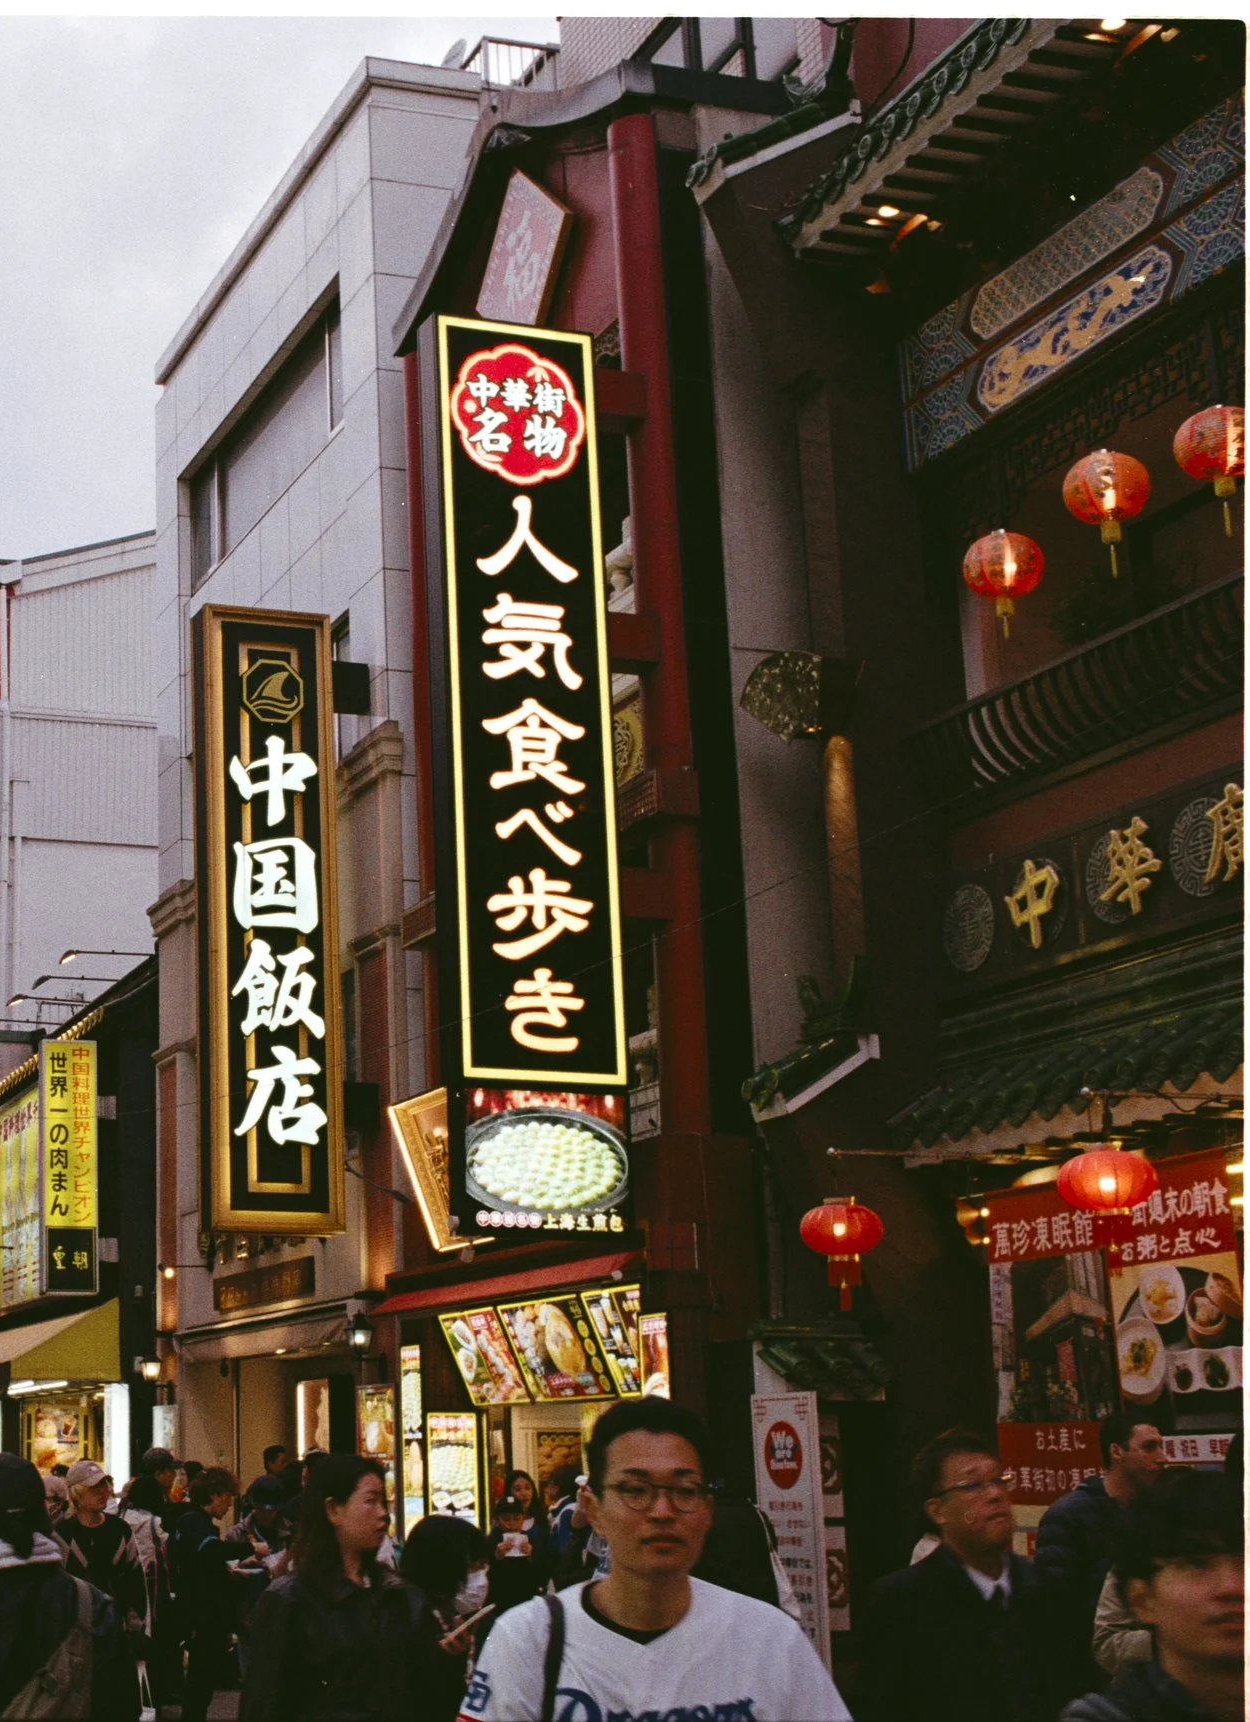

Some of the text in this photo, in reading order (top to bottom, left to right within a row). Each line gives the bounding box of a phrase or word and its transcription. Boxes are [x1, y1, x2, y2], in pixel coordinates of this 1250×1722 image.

[466, 373, 567, 419] 中華街
[468, 407, 568, 460] 名物
[476, 495, 594, 1053] 人気食べ歩き
[229, 735, 328, 1146] 中国飯店
[49, 1051, 69, 1217] 世界一の肉まん
[71, 1047, 91, 1222] 中国料理世界チャンピオン
[1121, 1228, 1222, 1262] お粥と点心
